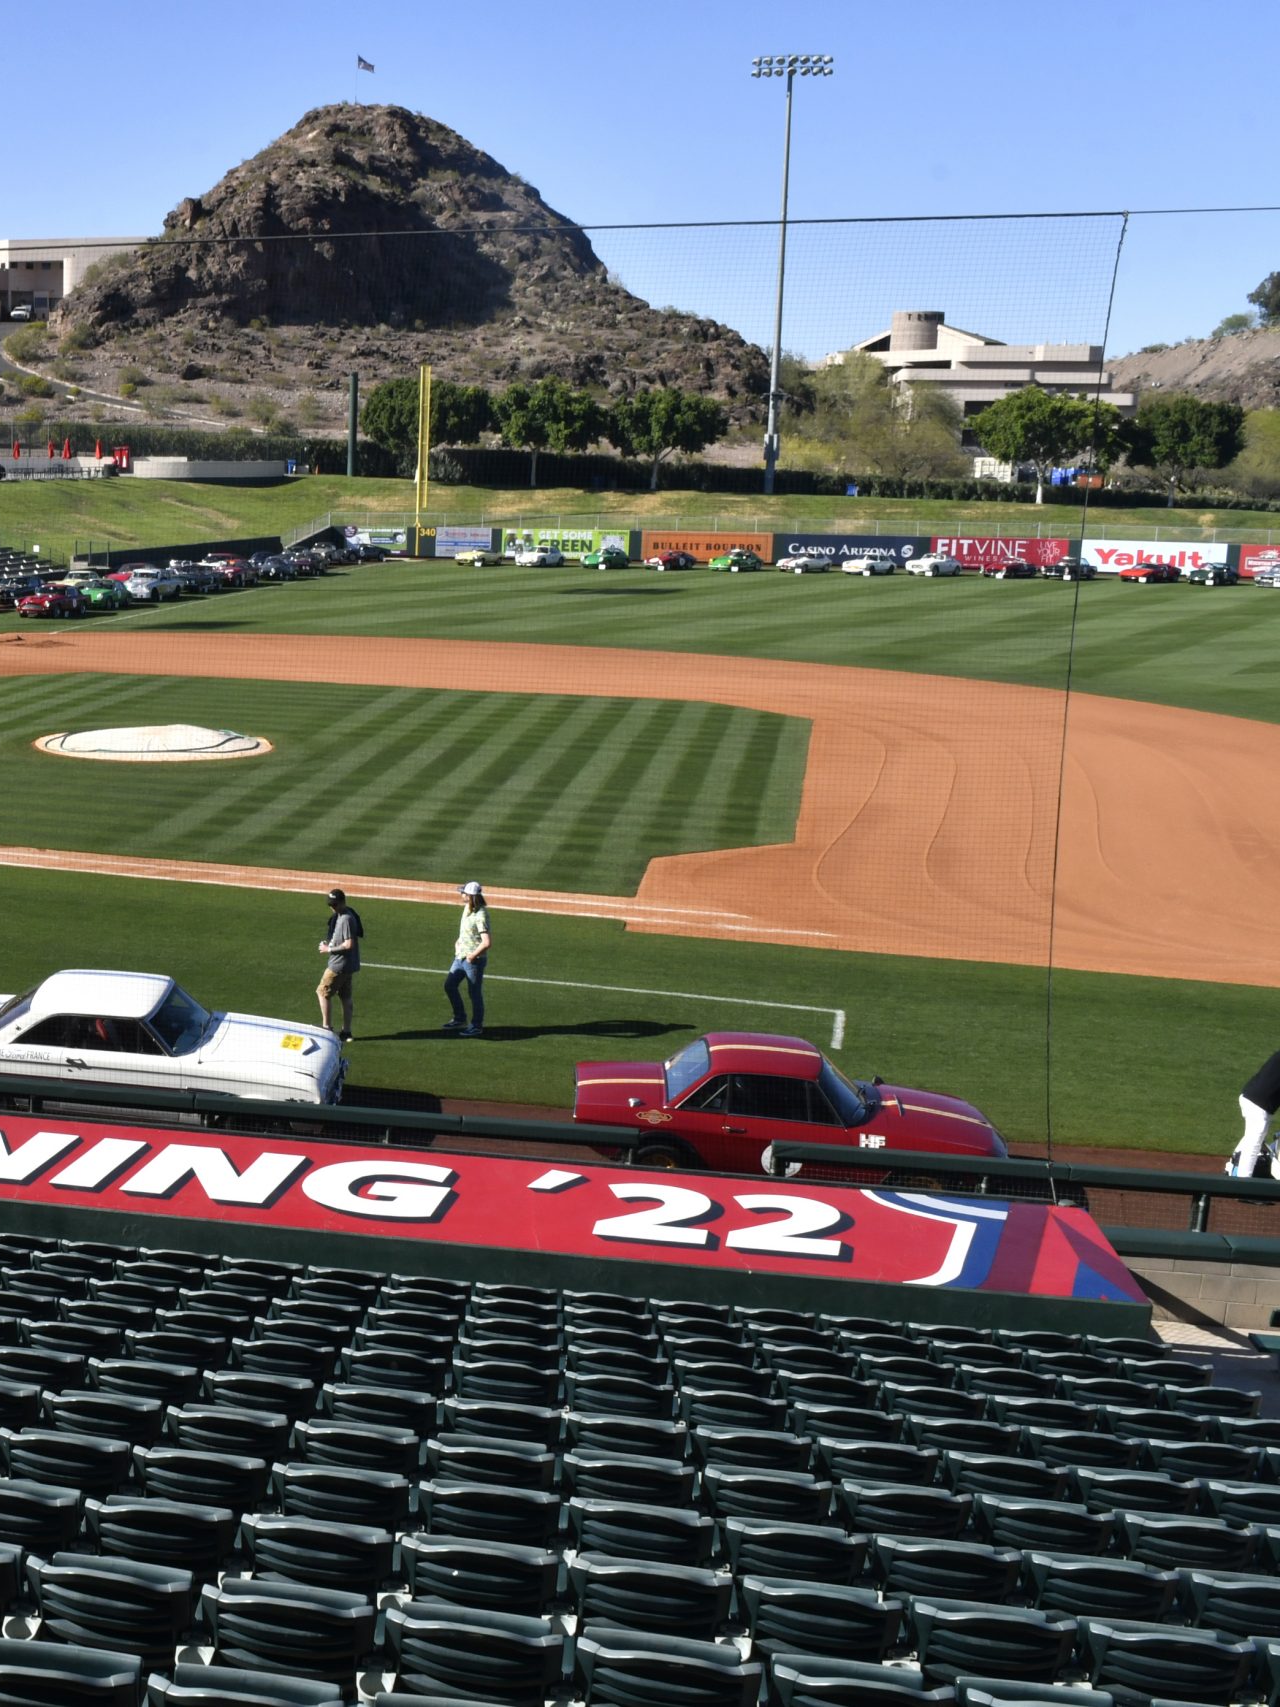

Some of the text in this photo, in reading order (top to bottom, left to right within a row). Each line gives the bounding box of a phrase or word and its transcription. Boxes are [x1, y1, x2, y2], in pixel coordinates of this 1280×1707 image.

[419, 528, 436, 537] 340
[539, 530, 558, 539] GET
[562, 531, 593, 540] SOME
[652, 542, 700, 551] BULLEIT
[936, 538, 1027, 560] FITVINE
[1040, 541, 1058, 549] LIVE
[1037, 548, 1060, 557] YOUR
[1094, 548, 1204, 569] Yakult
[26, 1050, 51, 1061] FRANCE
[526, 1168, 856, 1264] '22
